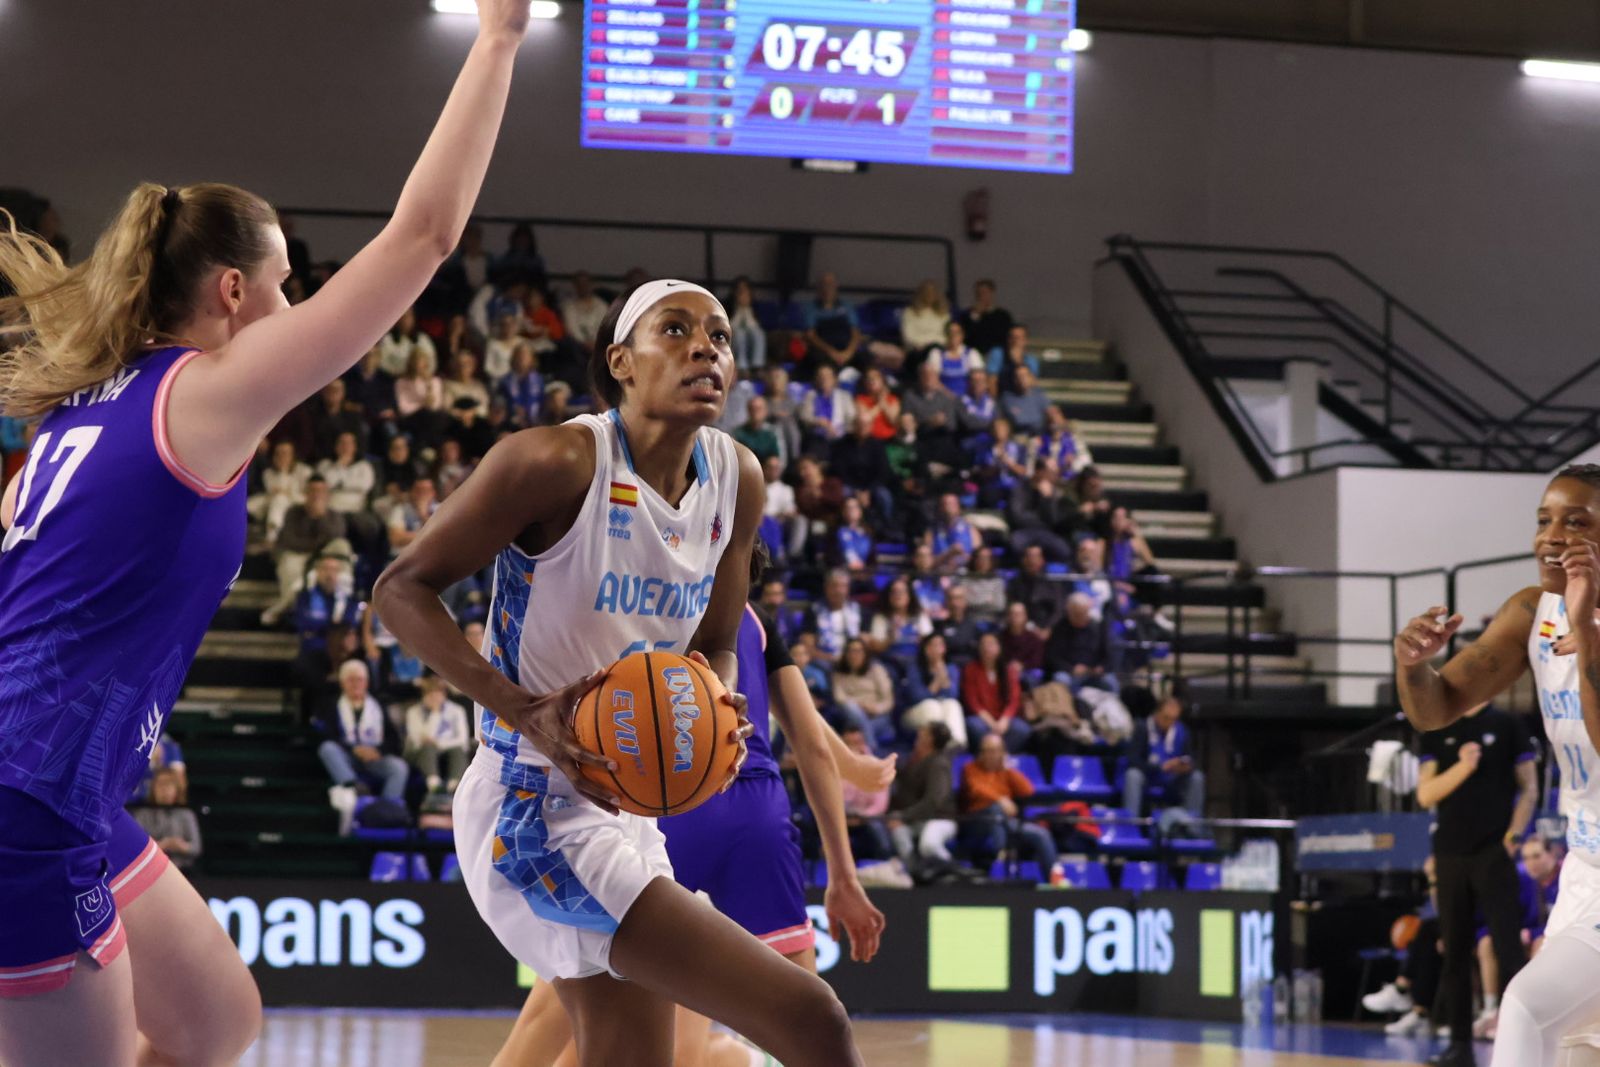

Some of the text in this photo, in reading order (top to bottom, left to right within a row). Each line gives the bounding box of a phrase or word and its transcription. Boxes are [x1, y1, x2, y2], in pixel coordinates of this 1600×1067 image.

[762, 23, 906, 78] 07:45
[769, 86, 794, 120] 0
[876, 92, 896, 126] 1
[2, 426, 103, 551] 17
[608, 527, 632, 540] rrea
[662, 666, 700, 774] Wilson
[208, 896, 425, 968] pans
[1033, 906, 1174, 996] pans
